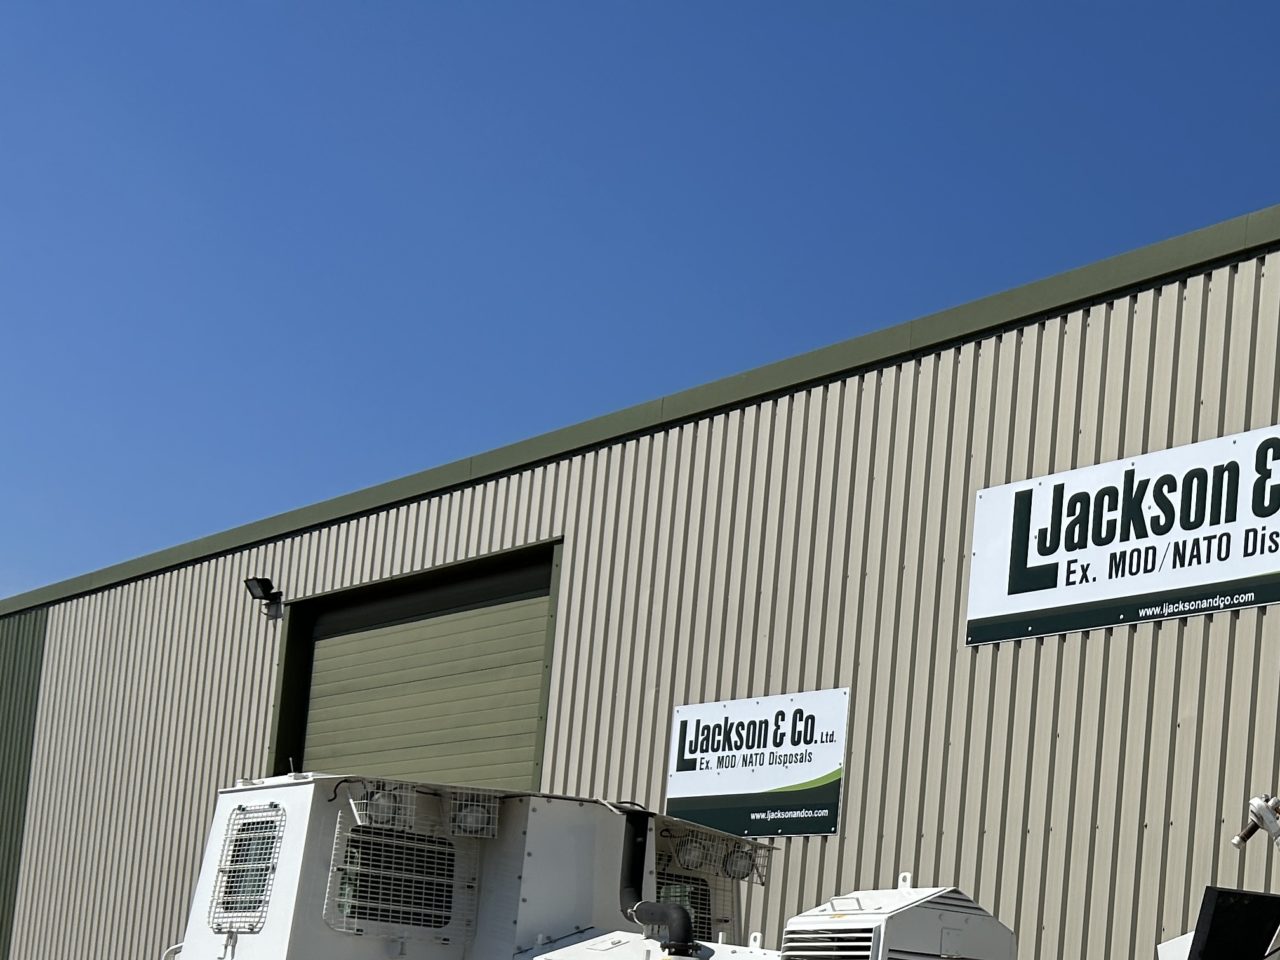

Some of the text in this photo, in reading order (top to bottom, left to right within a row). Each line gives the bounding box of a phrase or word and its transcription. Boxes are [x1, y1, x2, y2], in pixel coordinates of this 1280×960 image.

[1065, 558, 1098, 587] Ex.
[1108, 532, 1232, 580] MOD/NATO
[1138, 591, 1255, 618] www.ljacksonandco.com
[772, 709, 787, 748] &
[790, 708, 818, 747] Co.
[820, 730, 837, 744] Ltd.
[699, 756, 713, 771] Ex.
[768, 748, 813, 768] Disposals
